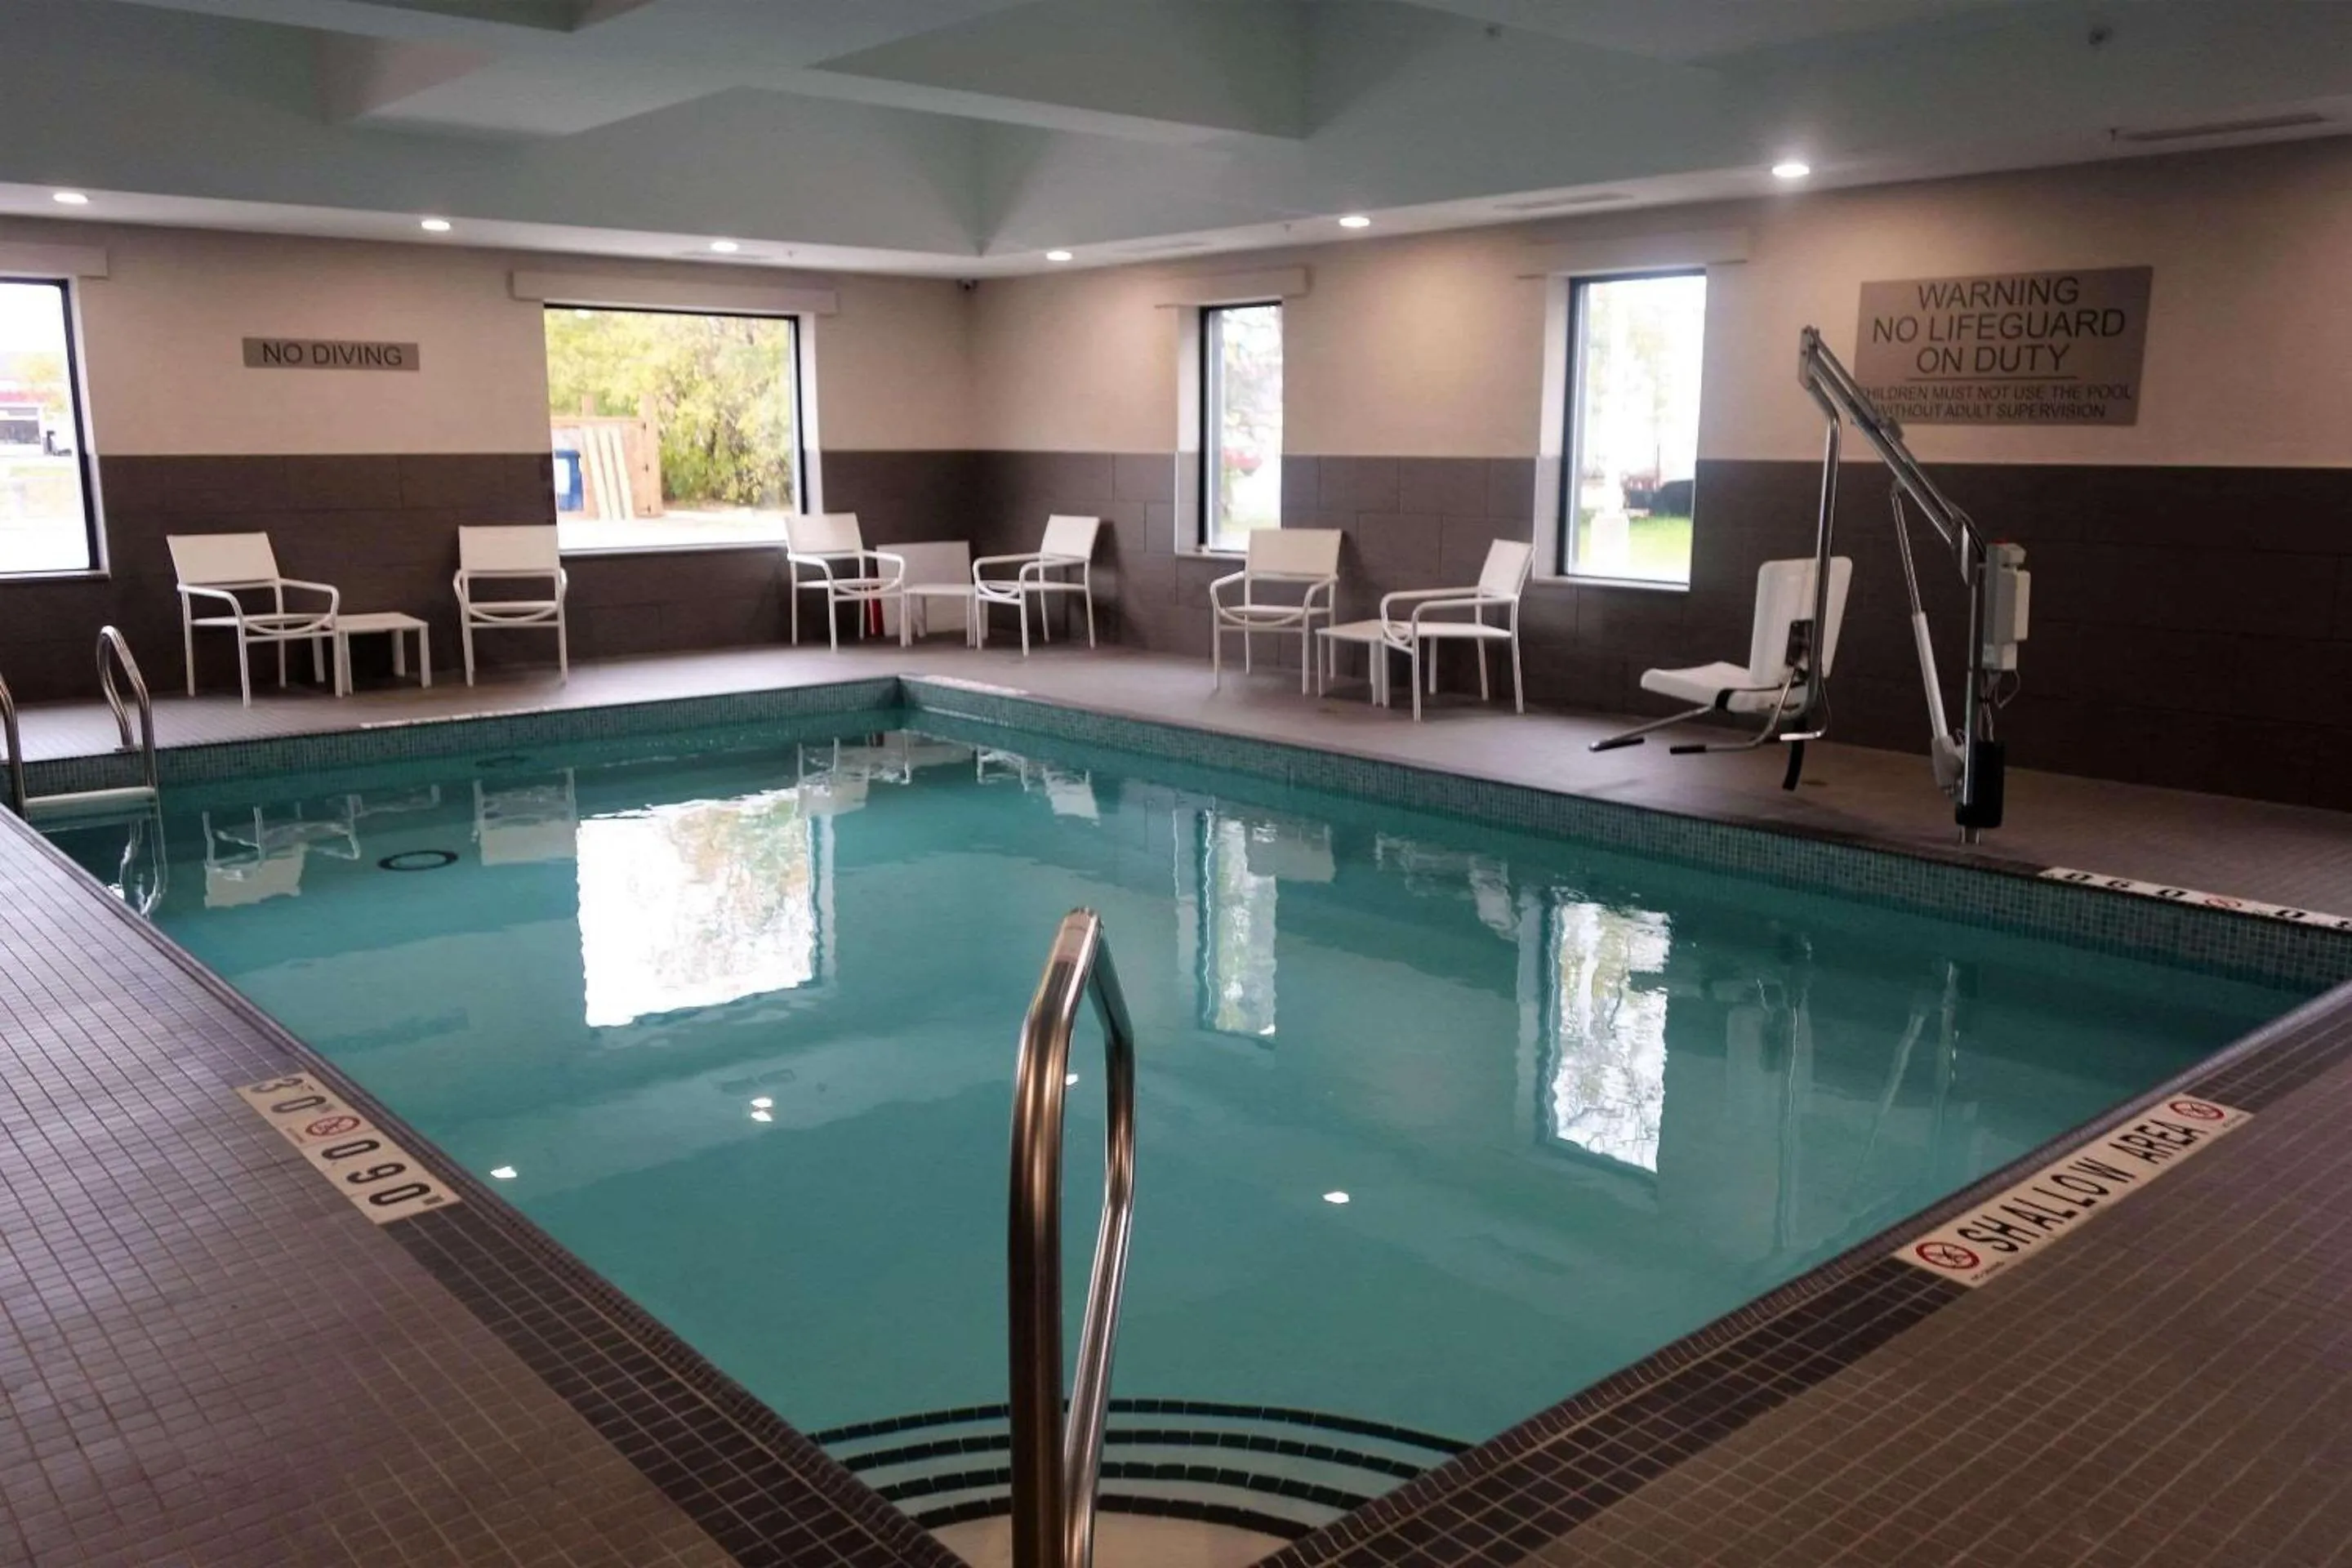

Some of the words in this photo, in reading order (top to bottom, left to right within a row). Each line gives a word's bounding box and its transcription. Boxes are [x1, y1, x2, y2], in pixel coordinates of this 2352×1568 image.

[1918, 276, 2079, 311] WARNING
[1873, 316, 1918, 344] NO
[1930, 309, 2126, 341] LIFEGUARD
[262, 341, 304, 364] NO
[312, 343, 403, 366] DIVING
[1916, 346, 1962, 374] ON
[1975, 344, 2071, 372] DUTY
[1866, 385, 1928, 401] HILDREN
[1932, 385, 1971, 401] MUST
[1977, 385, 2007, 400] NOT
[2014, 384, 2046, 400] USE
[2051, 384, 2081, 400] THE
[2088, 383, 2132, 400] POOL
[1945, 403, 1989, 419] ADULT
[1993, 402, 2106, 419] SUPERVISION
[1957, 1156, 2136, 1253] SHALLOW
[2108, 1119, 2209, 1165] AREA
